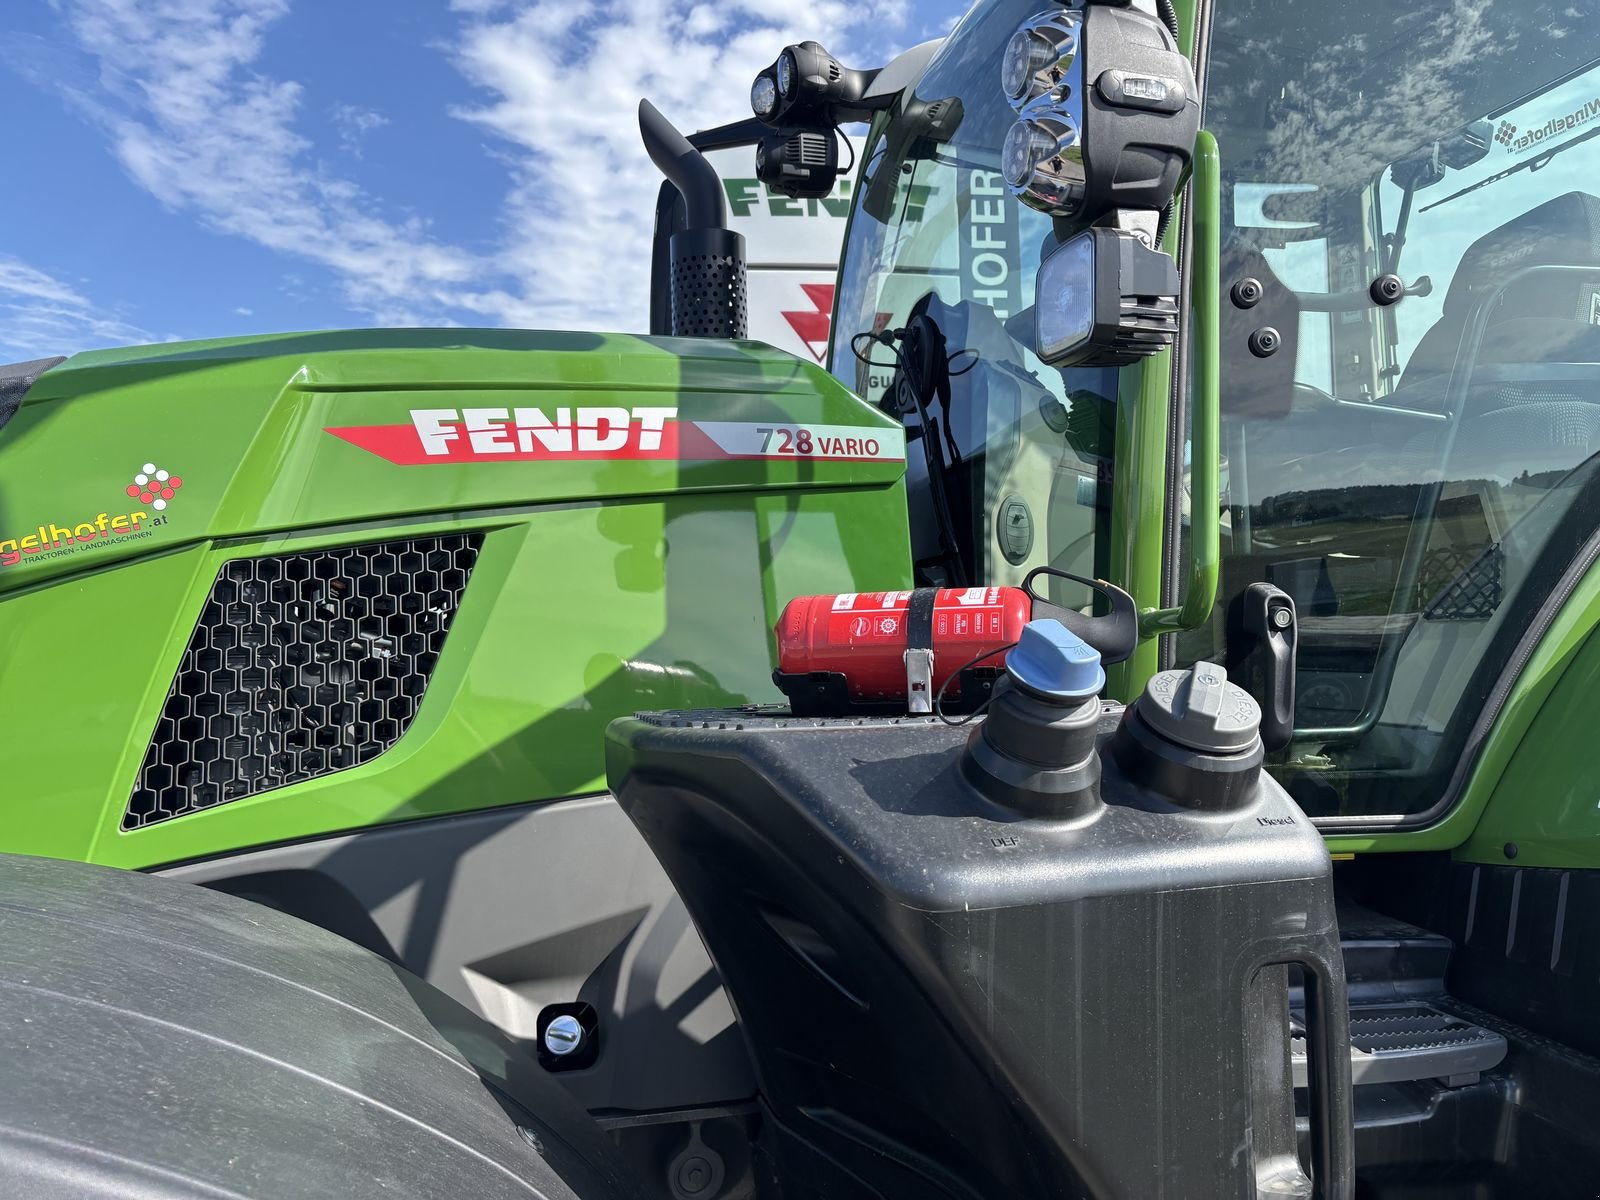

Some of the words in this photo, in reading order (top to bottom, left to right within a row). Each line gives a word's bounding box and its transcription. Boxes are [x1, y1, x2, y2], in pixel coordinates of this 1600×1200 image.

[970, 169, 1009, 326] HOFER
[408, 407, 679, 456] FENDT
[756, 427, 814, 455] 728
[819, 437, 881, 457] VARIO
[23, 547, 75, 565] TRAKTOREN
[80, 531, 152, 552] LANDMASCHINEN
[1226, 690, 1254, 723] DIESEL
[1256, 815, 1296, 827] Diesel
[990, 836, 1020, 848] DEF
